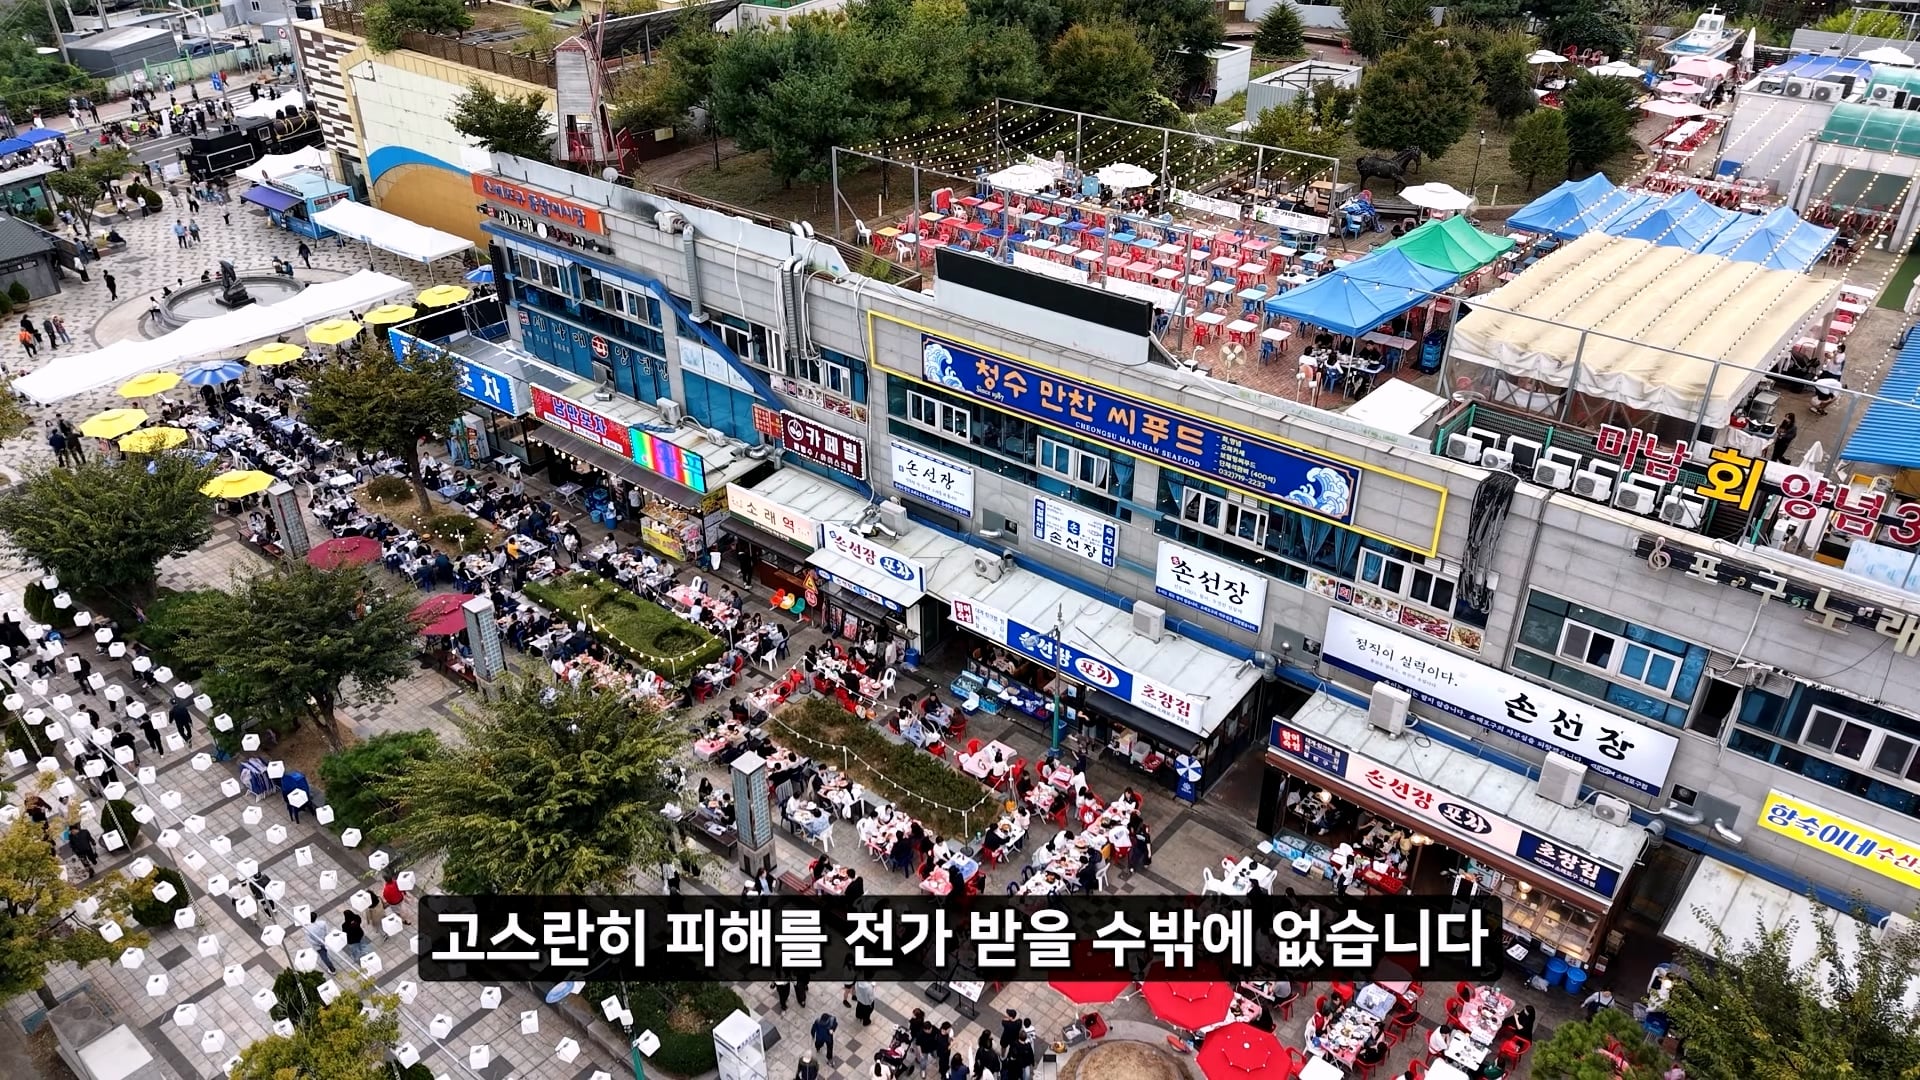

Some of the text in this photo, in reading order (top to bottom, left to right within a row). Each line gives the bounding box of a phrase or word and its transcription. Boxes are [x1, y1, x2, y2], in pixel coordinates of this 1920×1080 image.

[975, 358, 1204, 456] 청수 만찬 씨푸드
[805, 426, 858, 464] 카페빌
[1075, 421, 1201, 468] CHEONGSU MANCHAN SEAFOOD
[905, 459, 955, 490] 손선장
[1596, 424, 1692, 484] 미남
[1696, 446, 1766, 512] 회
[746, 501, 795, 534] 소래역
[834, 535, 912, 580] 손선장 포차
[1050, 531, 1097, 558] 손선장
[1171, 560, 1250, 605] 손선장
[1080, 659, 1115, 685] 포차
[1355, 637, 1394, 662] 정직이
[1400, 654, 1458, 687] 실력이다.
[1140, 683, 1191, 718] 초장집
[1504, 692, 1635, 761] 손선장
[1365, 769, 1488, 833] 손선장 포차
[1535, 841, 1601, 881] 초장집
[1767, 803, 1920, 874] 향숙이네 수산
